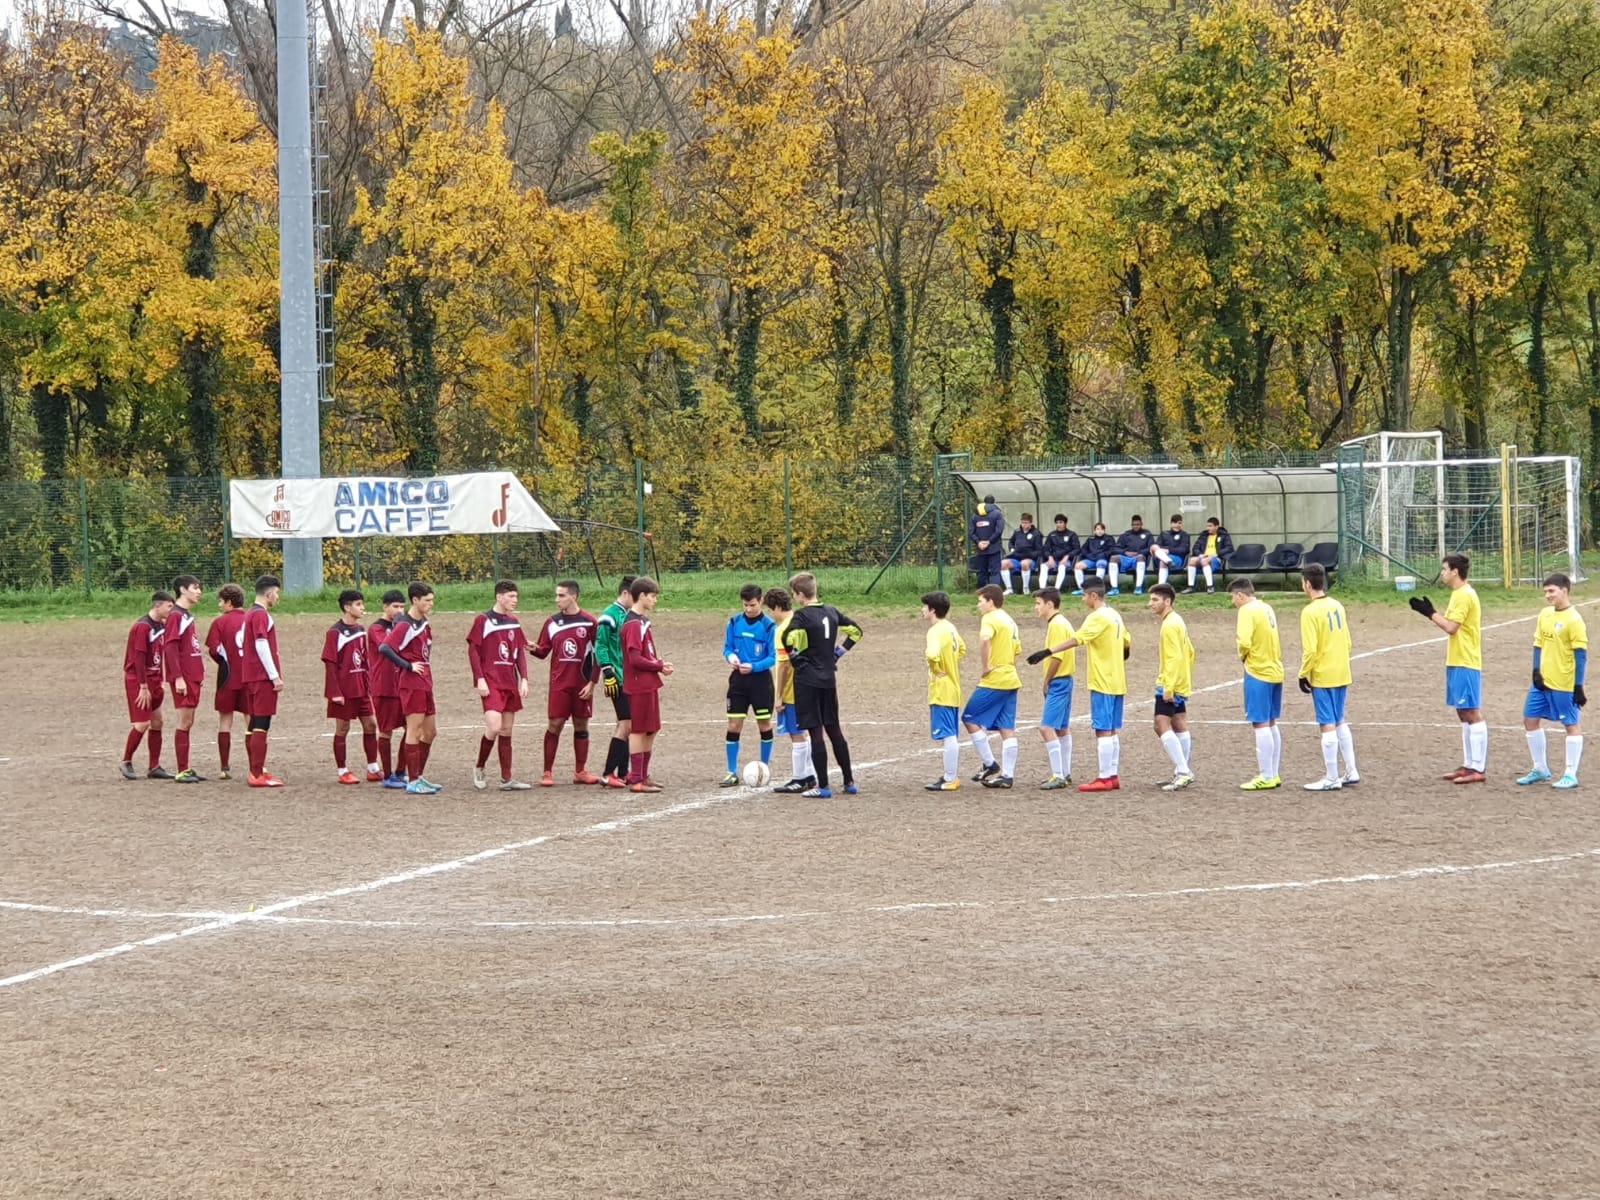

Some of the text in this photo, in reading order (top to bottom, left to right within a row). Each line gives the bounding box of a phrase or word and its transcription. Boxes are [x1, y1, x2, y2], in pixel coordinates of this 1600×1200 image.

[334, 480, 449, 507] AMICO
[822, 616, 830, 639] 1
[1327, 604, 1342, 632] 11
